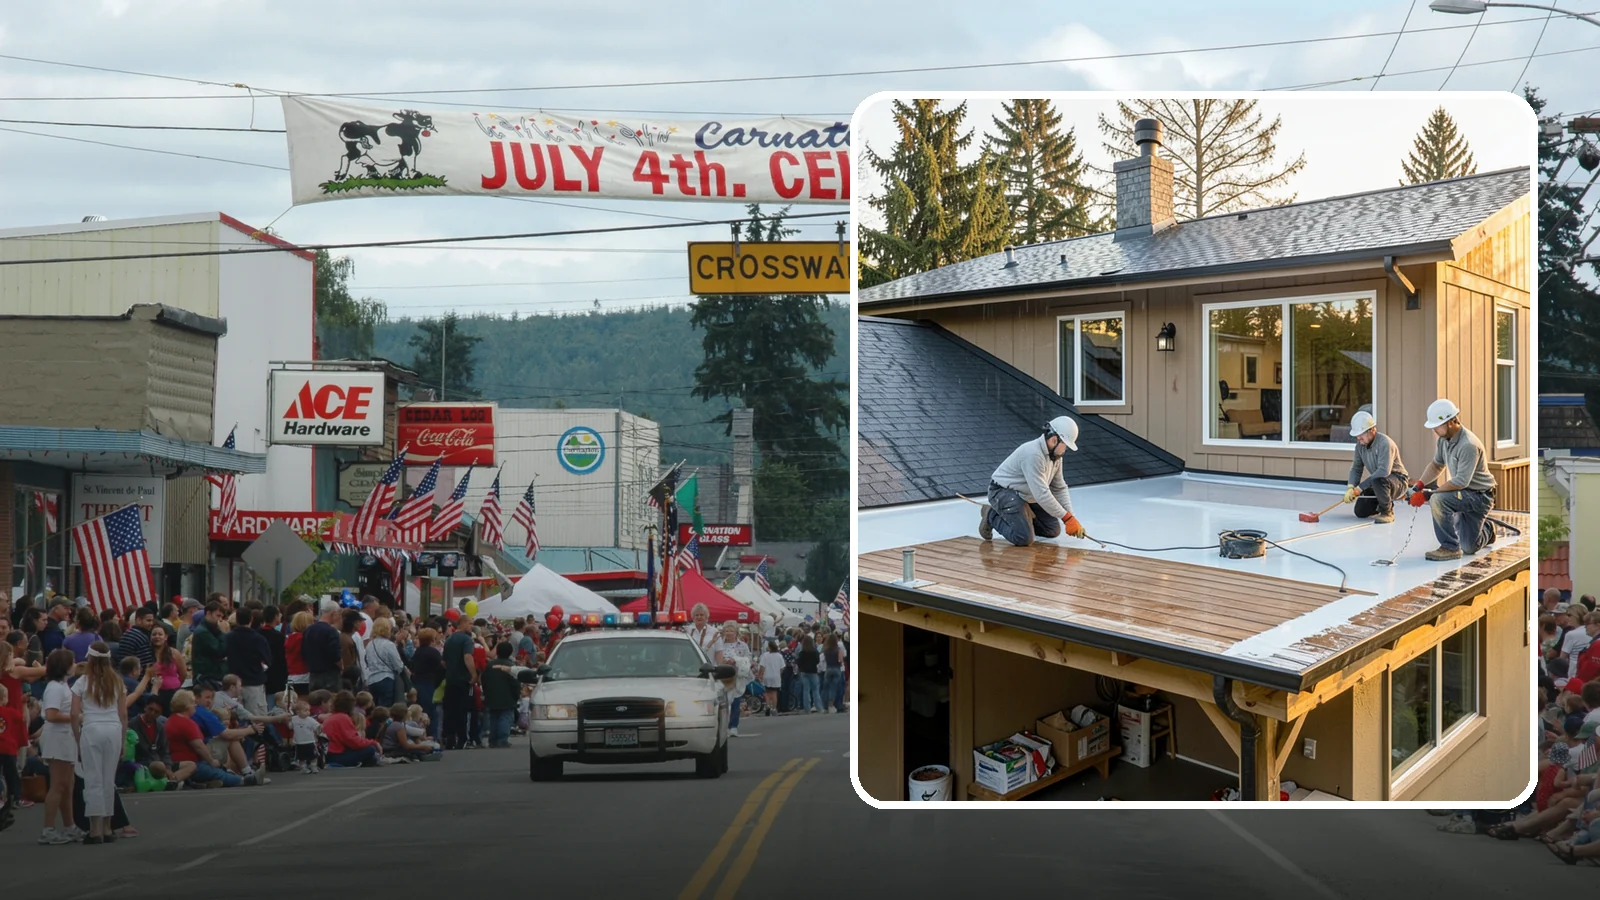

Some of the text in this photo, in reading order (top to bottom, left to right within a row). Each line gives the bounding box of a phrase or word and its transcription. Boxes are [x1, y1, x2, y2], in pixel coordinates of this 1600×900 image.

[481, 141, 605, 192] JULY
[632, 150, 746, 198] 4th.
[697, 254, 850, 280] CROSSWA
[282, 380, 373, 420] ACE
[405, 409, 485, 422] CEDAR LOG
[283, 421, 371, 436] Hardware
[416, 428, 476, 447] Coca-Cola
[353, 467, 384, 480] Simpl
[95, 484, 124, 495] Vincent
[126, 486, 136, 494] de
[137, 486, 155, 495] Paul
[81, 503, 154, 522] THT
[212, 516, 331, 535] HARDARE
[688, 526, 741, 535] CRNATION
[699, 535, 730, 543] GLASS
